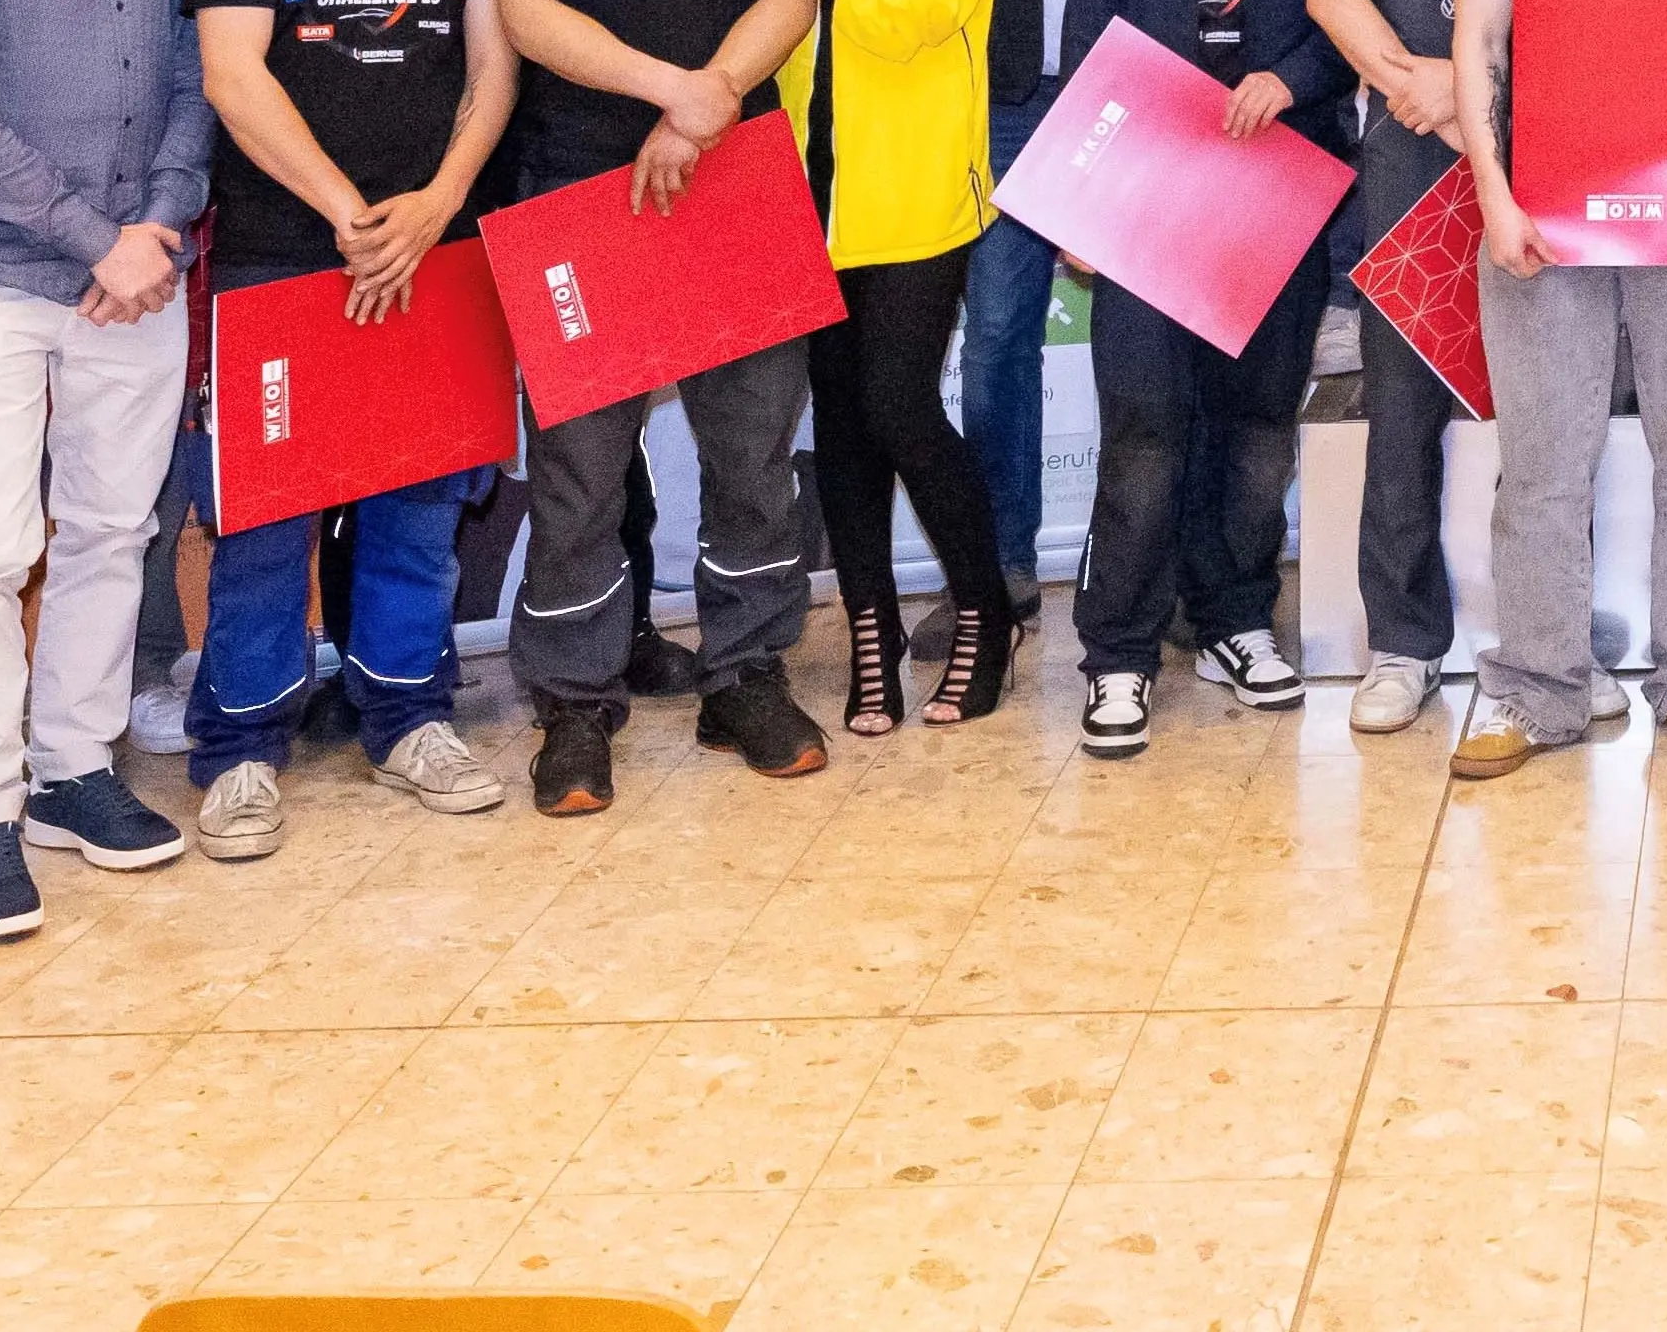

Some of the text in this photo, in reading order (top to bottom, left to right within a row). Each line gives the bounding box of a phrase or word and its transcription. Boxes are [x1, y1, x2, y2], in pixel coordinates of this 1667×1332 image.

[300, 26, 332, 38] SATA
[1069, 120, 1110, 169] WKO
[1608, 202, 1663, 220] WKO
[554, 284, 583, 341] WKO
[264, 383, 282, 443] WKO
